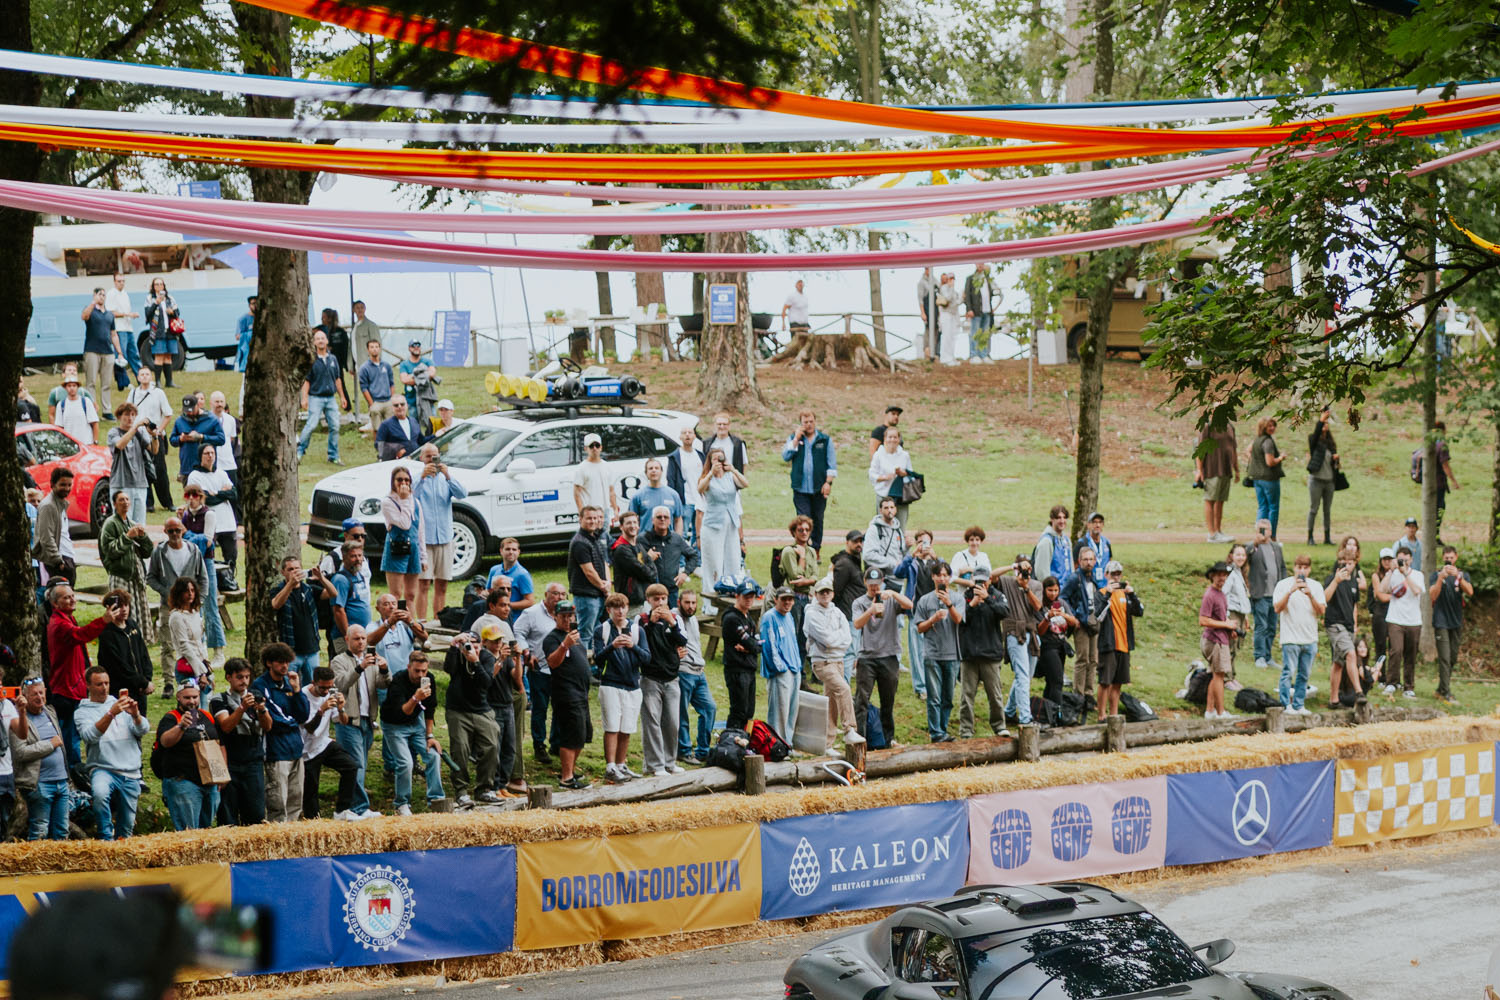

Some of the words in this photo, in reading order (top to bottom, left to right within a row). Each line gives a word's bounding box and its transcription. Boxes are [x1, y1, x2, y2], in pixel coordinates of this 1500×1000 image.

[990, 808, 1032, 835] TUTTO
[1050, 802, 1093, 828] TUTTO
[1111, 796, 1152, 821] TUTTO
[829, 835, 950, 874] KALEON
[990, 831, 1032, 870] BENE
[1050, 824, 1093, 862] BENE
[1111, 818, 1152, 855] BENE
[350, 871, 394, 903] AUTOMOBILE
[394, 878, 409, 900] CLUB
[541, 858, 742, 913] BORROMEODESILVA
[831, 880, 871, 892] HERITAGE
[872, 873, 926, 888] MANAGEMENT
[348, 907, 371, 943] VERBANO
[372, 935, 395, 946] CUSIO
[395, 902, 411, 937] OSSOLA
